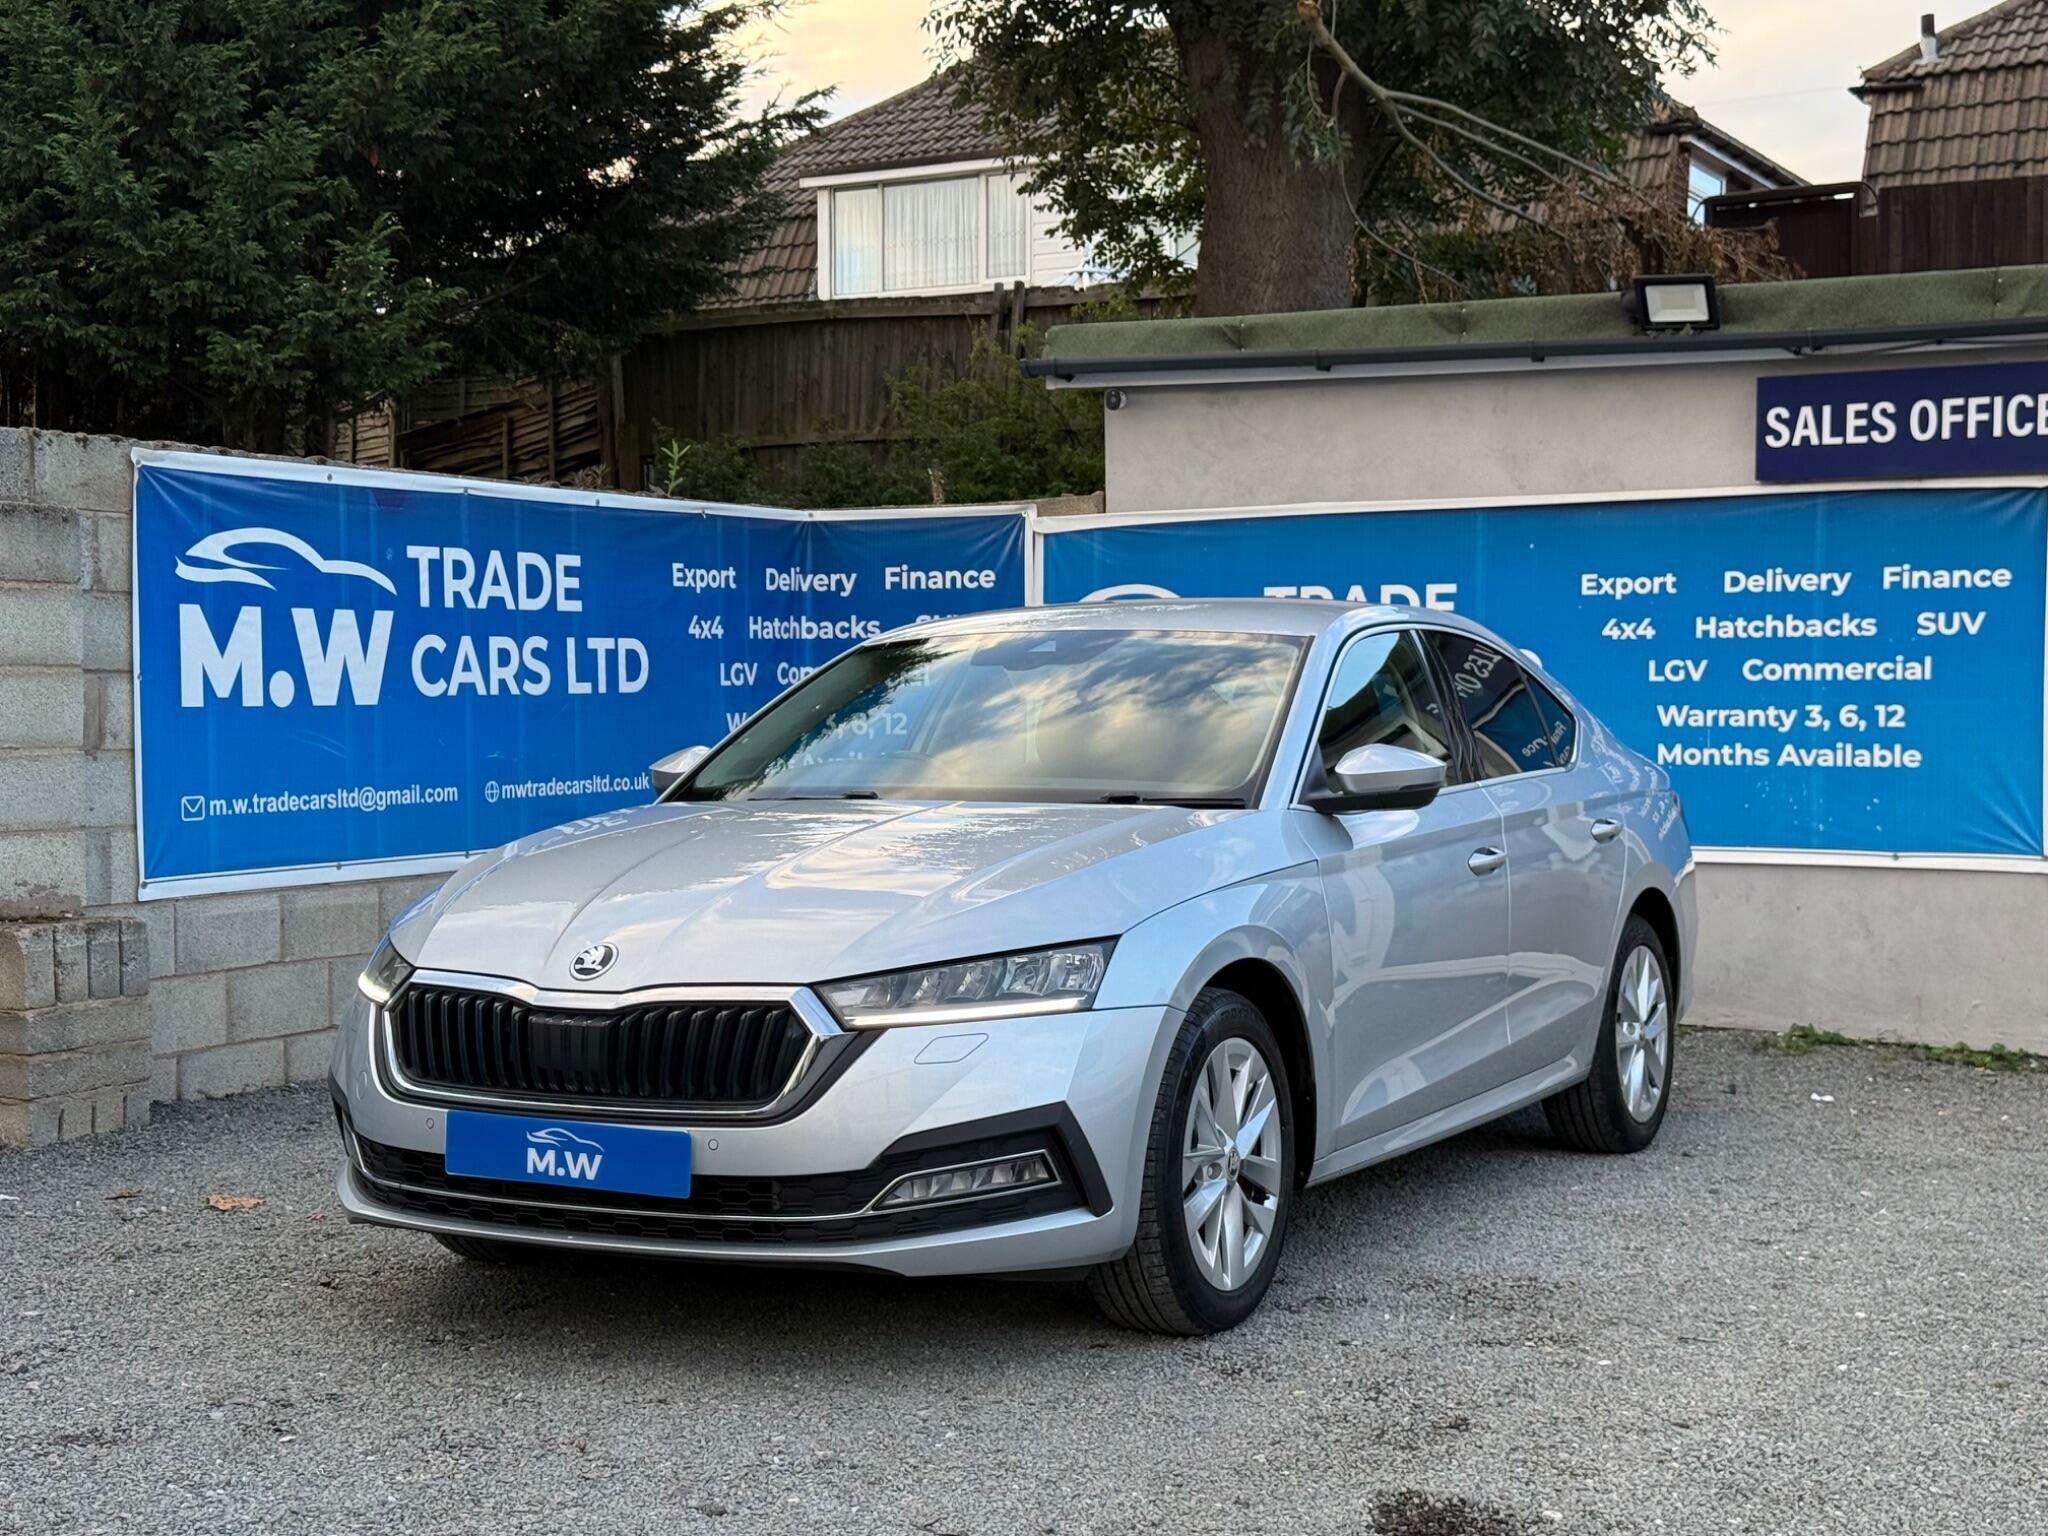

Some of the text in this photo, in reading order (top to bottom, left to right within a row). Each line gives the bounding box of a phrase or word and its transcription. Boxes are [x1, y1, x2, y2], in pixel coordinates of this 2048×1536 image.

[1765, 401, 1897, 449] SALES
[406, 545, 583, 613] TRADE
[673, 562, 996, 597] Export Delivery Finance
[1581, 564, 2012, 600] Export Delivery Finance
[688, 615, 881, 640] 4x4 Hatchbacks
[1601, 611, 1986, 640] 4x4 Hatchbacks SUV
[179, 603, 394, 708] M.W
[411, 634, 649, 698] CARS LTD
[1648, 655, 1932, 682] LGV Commercial
[719, 662, 758, 686] LGV
[882, 712, 908, 736] 12
[1656, 704, 1906, 733] Warranty 3, 6, 12
[1656, 743, 1922, 768] Months Available
[209, 784, 458, 817] m.w.tradecarsltd@gmail.com
[501, 772, 650, 799] mwtradecarsltd.co.uk
[526, 1147, 603, 1181] M.W
